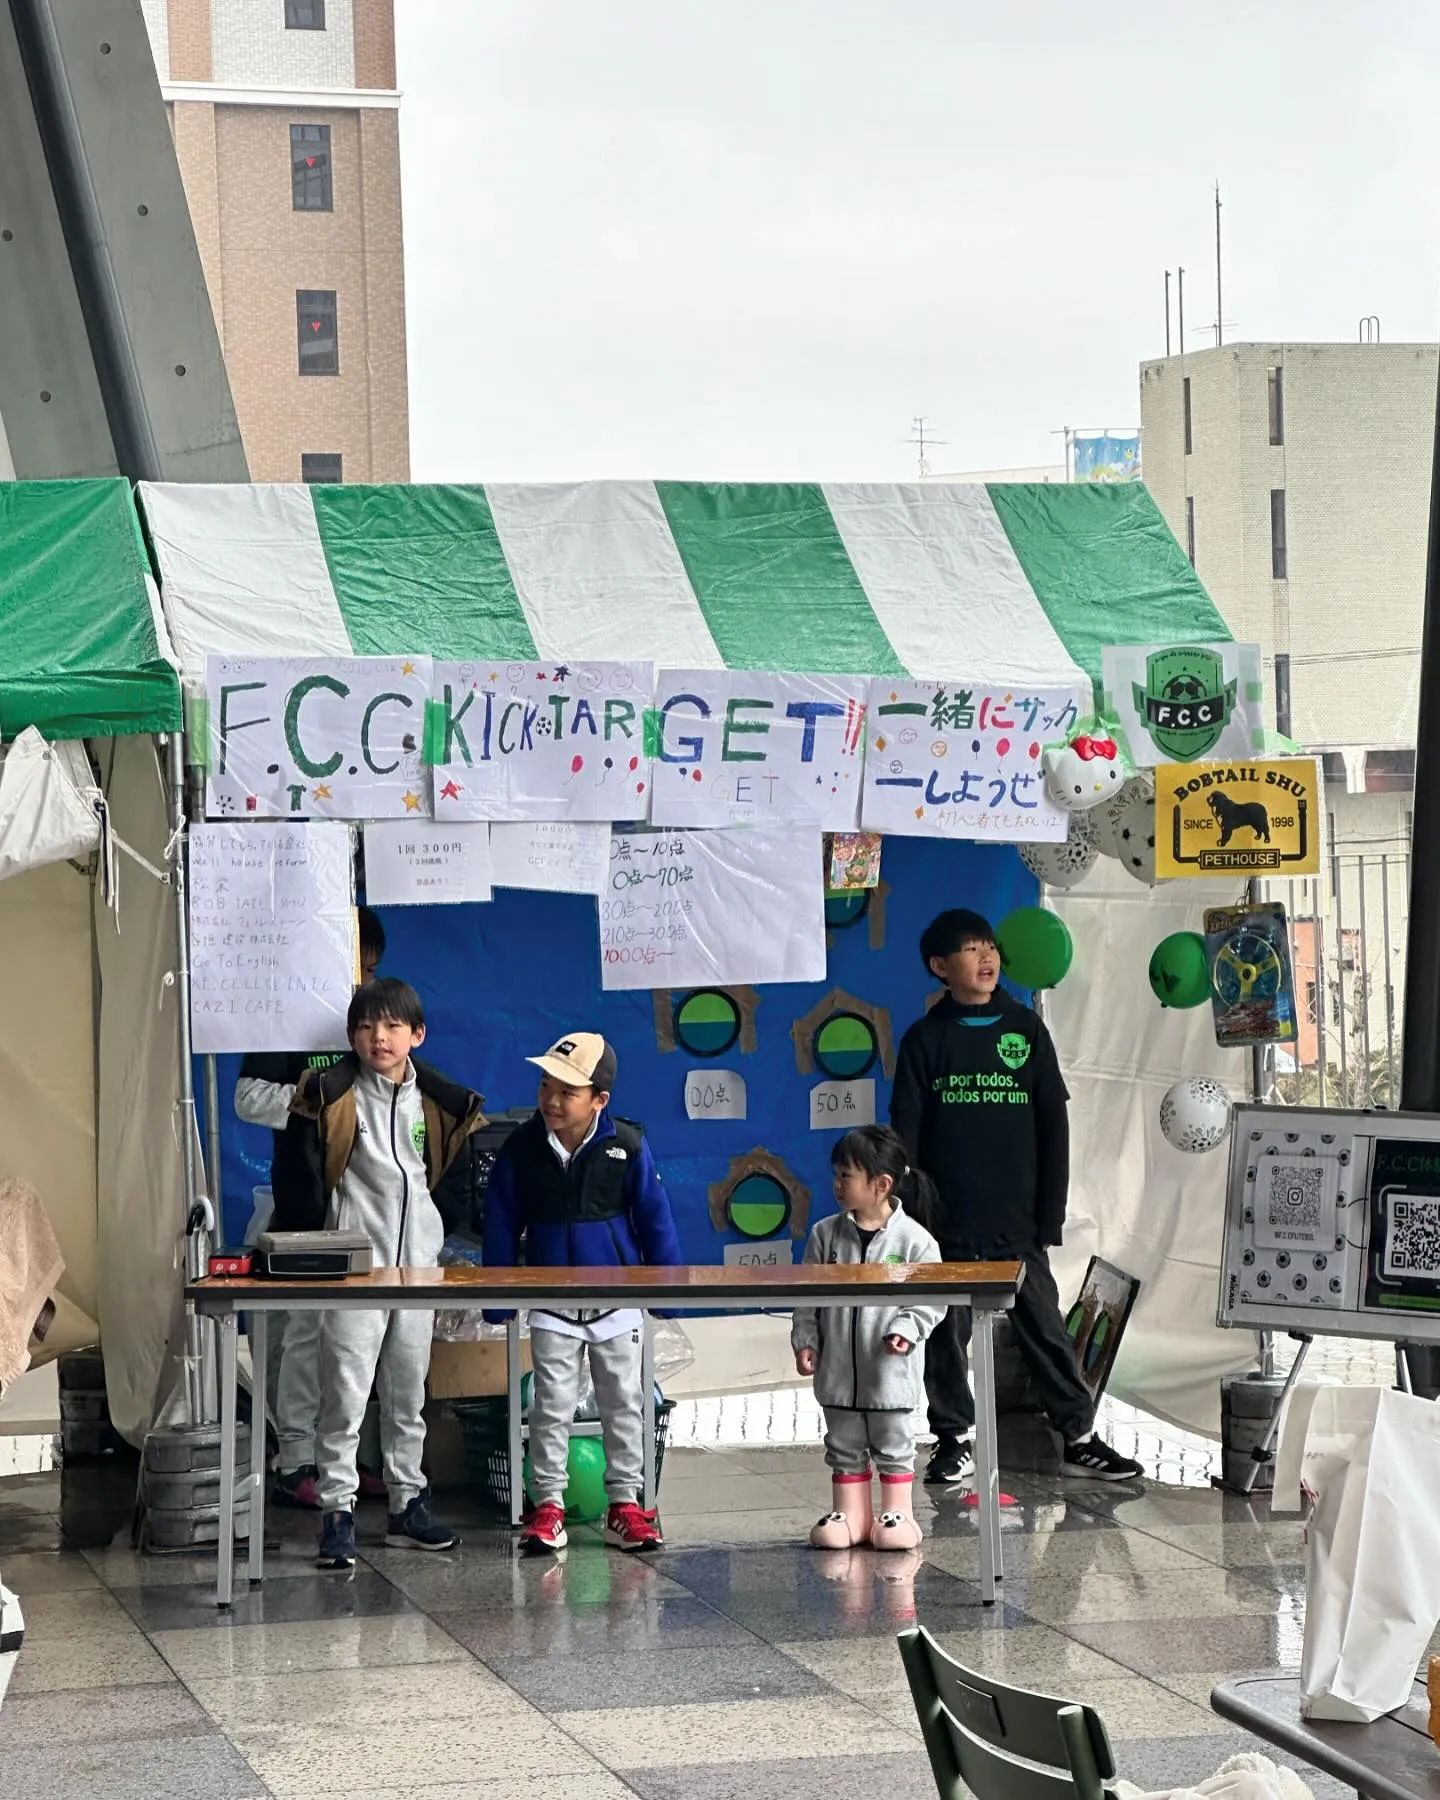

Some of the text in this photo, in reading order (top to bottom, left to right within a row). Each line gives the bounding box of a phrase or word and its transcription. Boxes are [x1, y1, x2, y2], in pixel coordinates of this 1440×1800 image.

[878, 690, 1079, 732] 一緒にサッカ
[444, 684, 537, 768] KICK
[1173, 768, 1308, 801] BOBTAIL SHU
[1183, 816, 1295, 830] SINCE 1998
[1204, 853, 1275, 866] PETHOUSE
[307, 1055, 331, 1069] um
[949, 1074, 972, 1088] por
[816, 1091, 856, 1113] 50点
[942, 1088, 1029, 1104] todos por um
